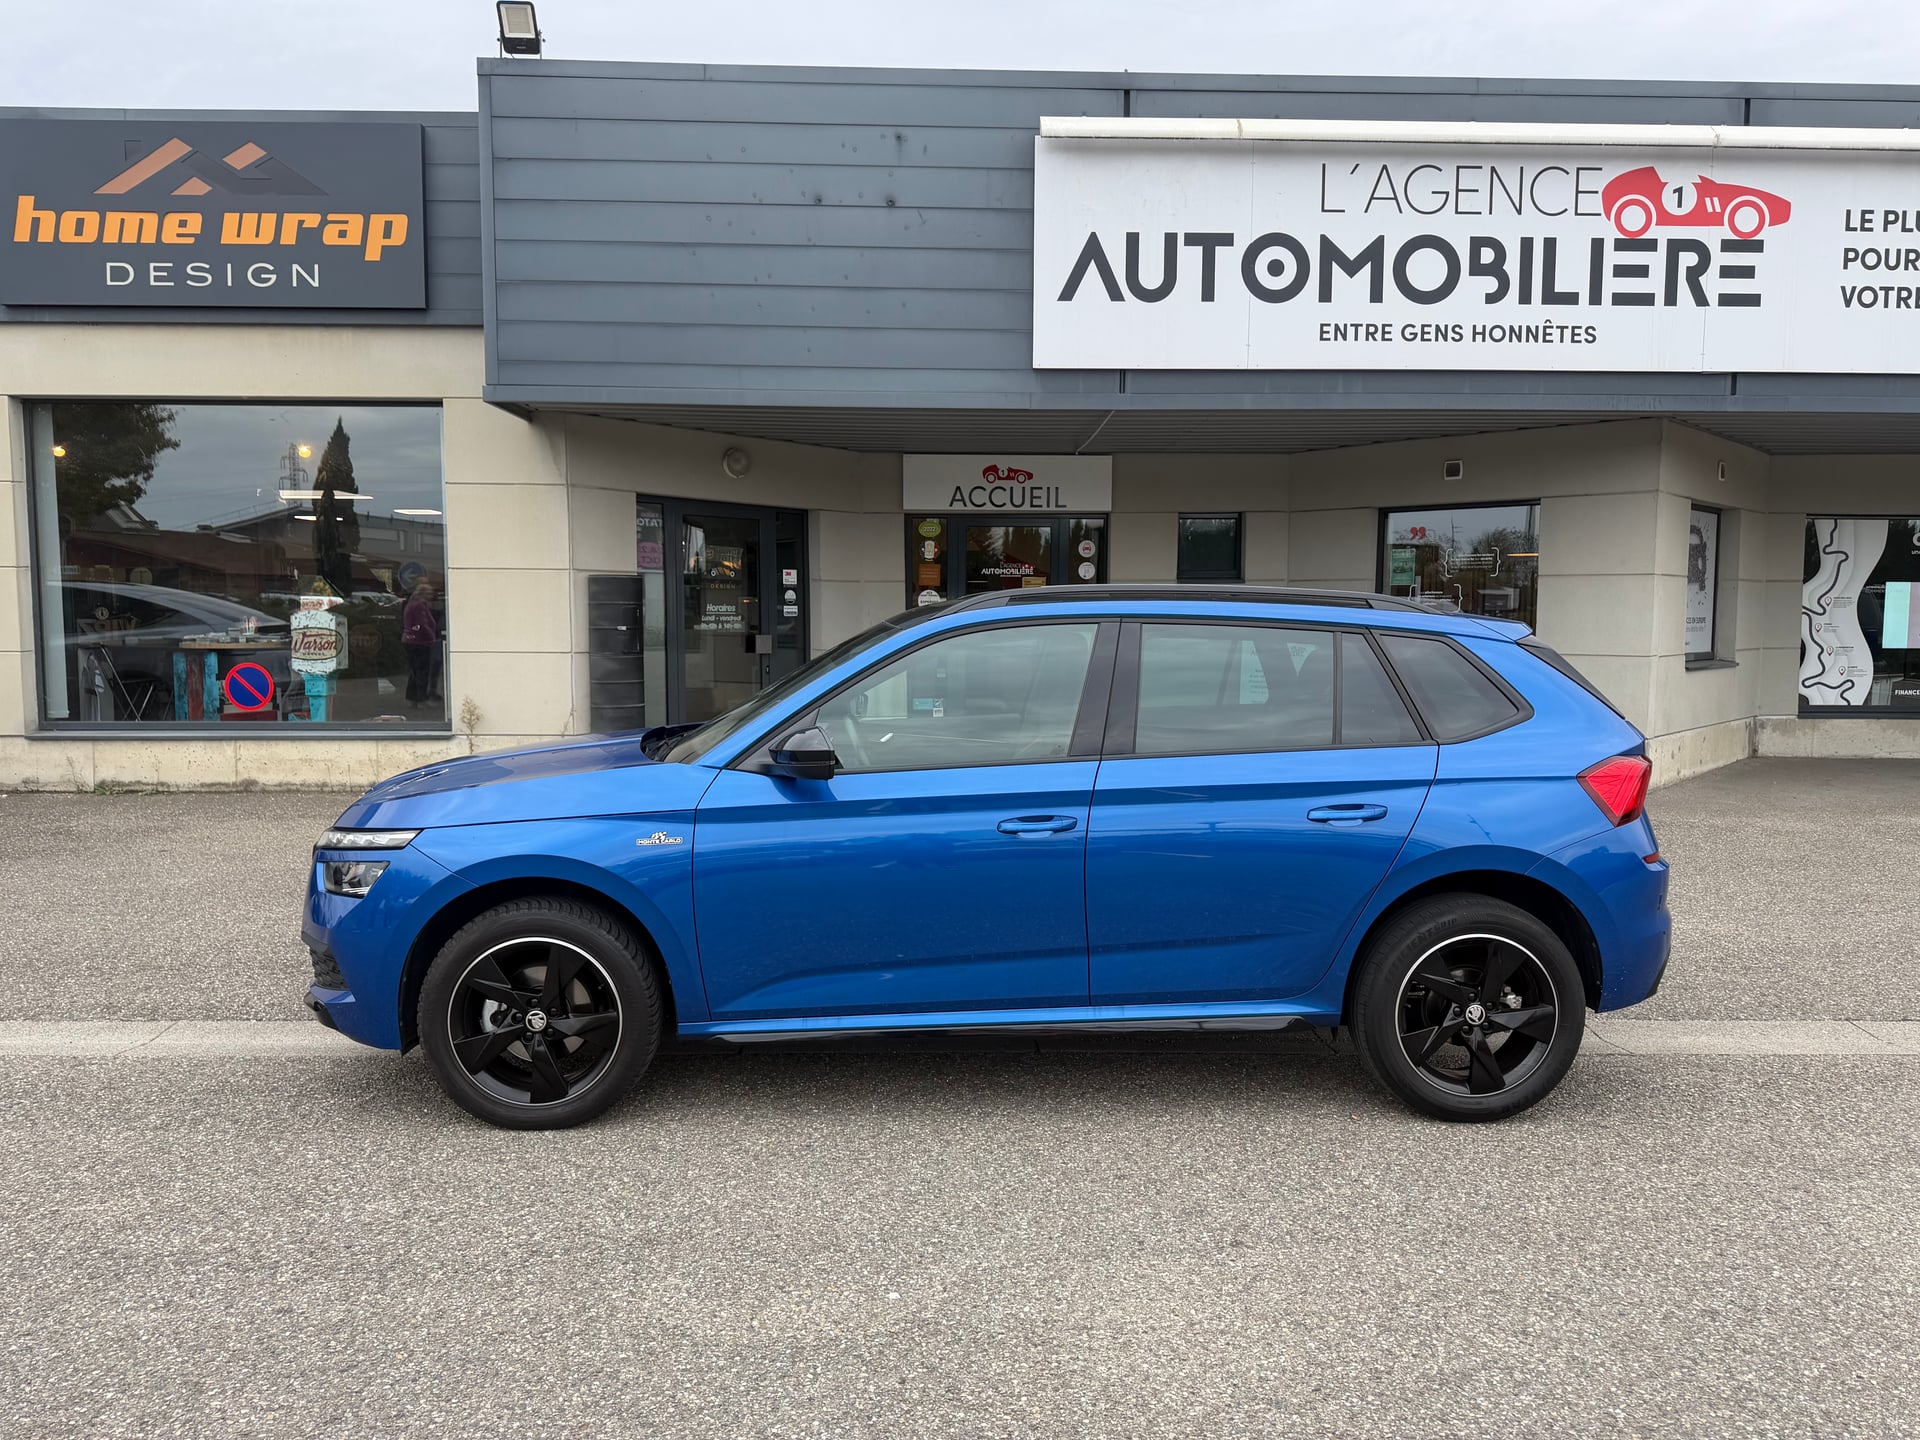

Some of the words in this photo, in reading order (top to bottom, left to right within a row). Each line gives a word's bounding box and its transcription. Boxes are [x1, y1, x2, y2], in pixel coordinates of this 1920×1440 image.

[1321, 162, 1603, 217] L'AGENCE
[1672, 185, 1684, 208] 1
[13, 195, 203, 244] home
[220, 212, 409, 262] wrap
[1845, 209, 1875, 232] LE
[1843, 247, 1920, 271] POUR
[105, 262, 320, 288] DESIGN
[1318, 323, 1393, 342] ENTRE
[1400, 323, 1464, 343] GENS
[1472, 319, 1598, 344] HONNÊTES
[949, 485, 1067, 509] ACCUEIL
[706, 603, 736, 612] Horaires
